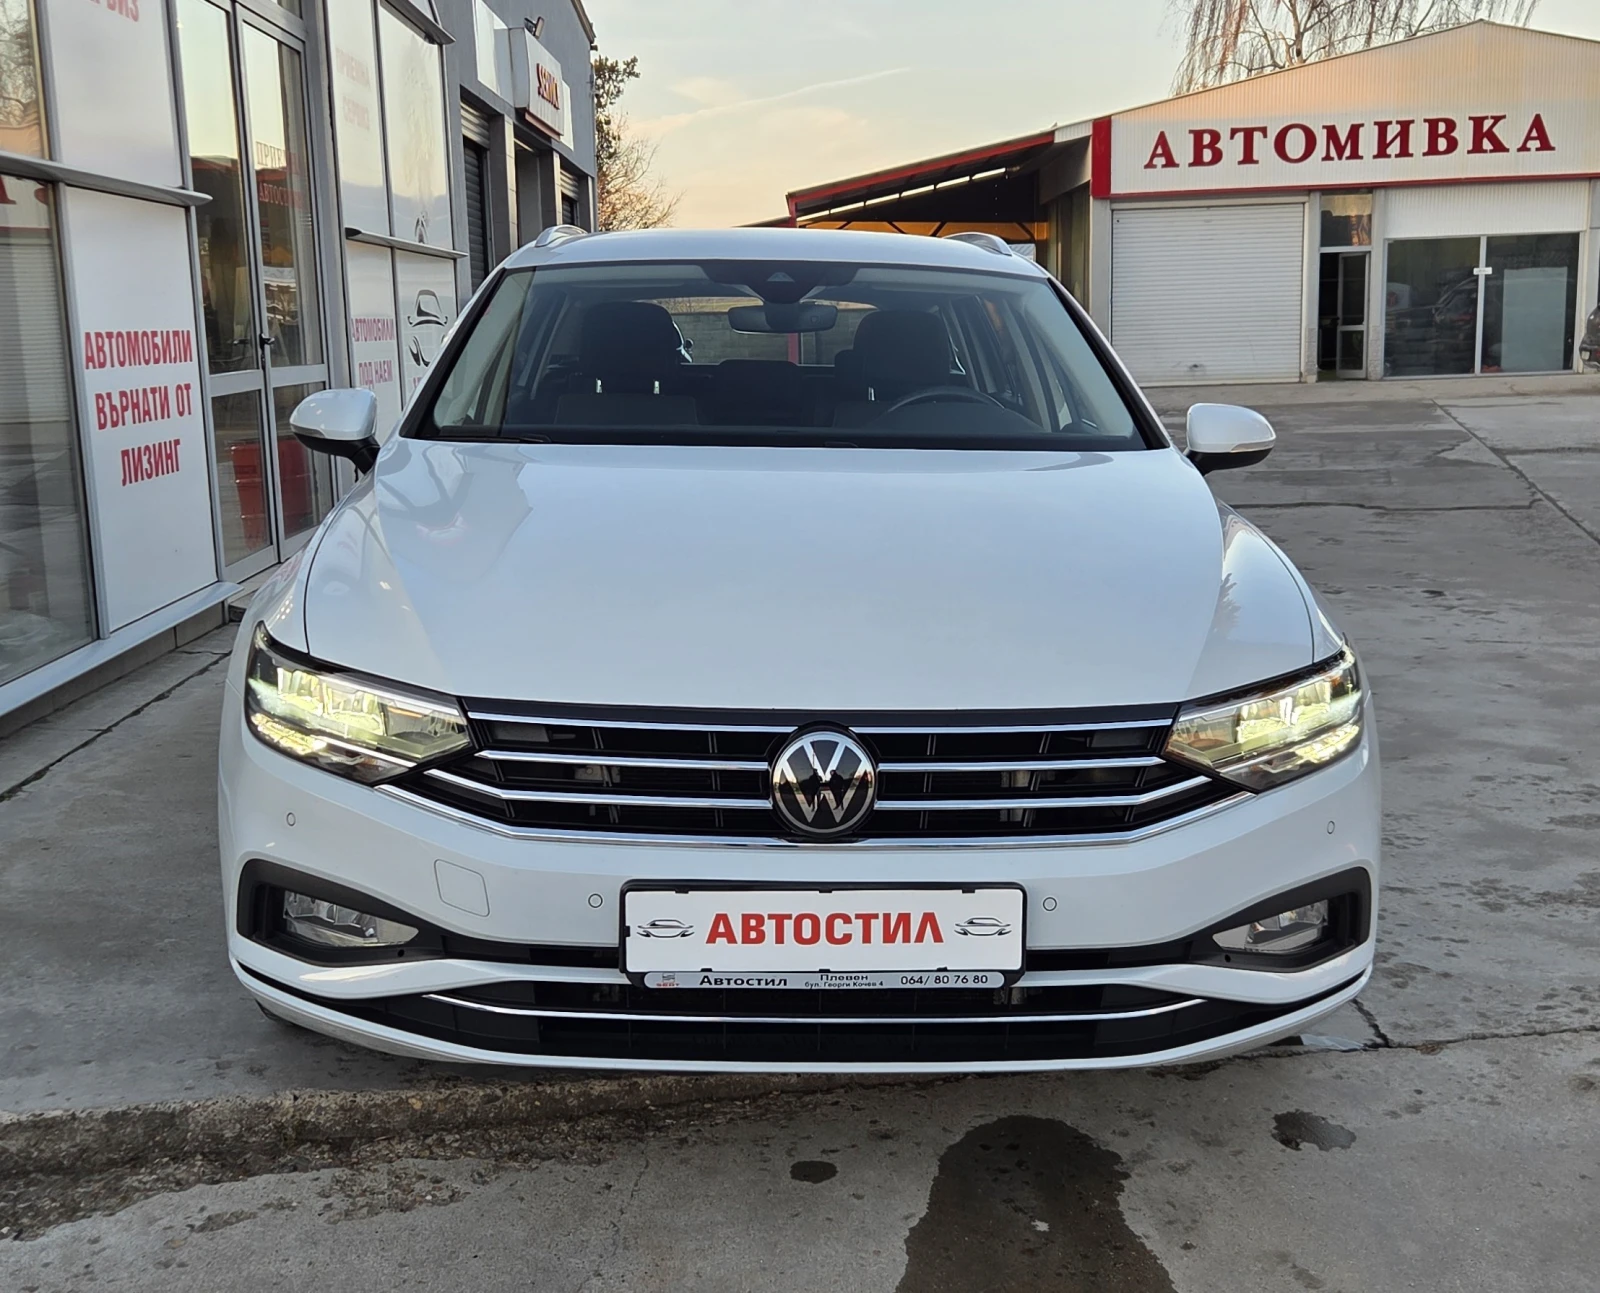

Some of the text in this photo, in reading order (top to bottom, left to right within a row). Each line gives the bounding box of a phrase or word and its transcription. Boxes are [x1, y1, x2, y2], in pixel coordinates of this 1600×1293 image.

[1143, 113, 1556, 170] АВТОМИВКА
[84, 330, 193, 370] АВТОМОБИЛИ
[94, 383, 192, 431] ВЪРНАТИ ОТ
[120, 438, 181, 487] ЛИЗИНГ
[705, 911, 944, 945] АВТОСТИЛ
[700, 975, 787, 986] Автостил
[900, 974, 988, 986] 064/ 80 76 80
